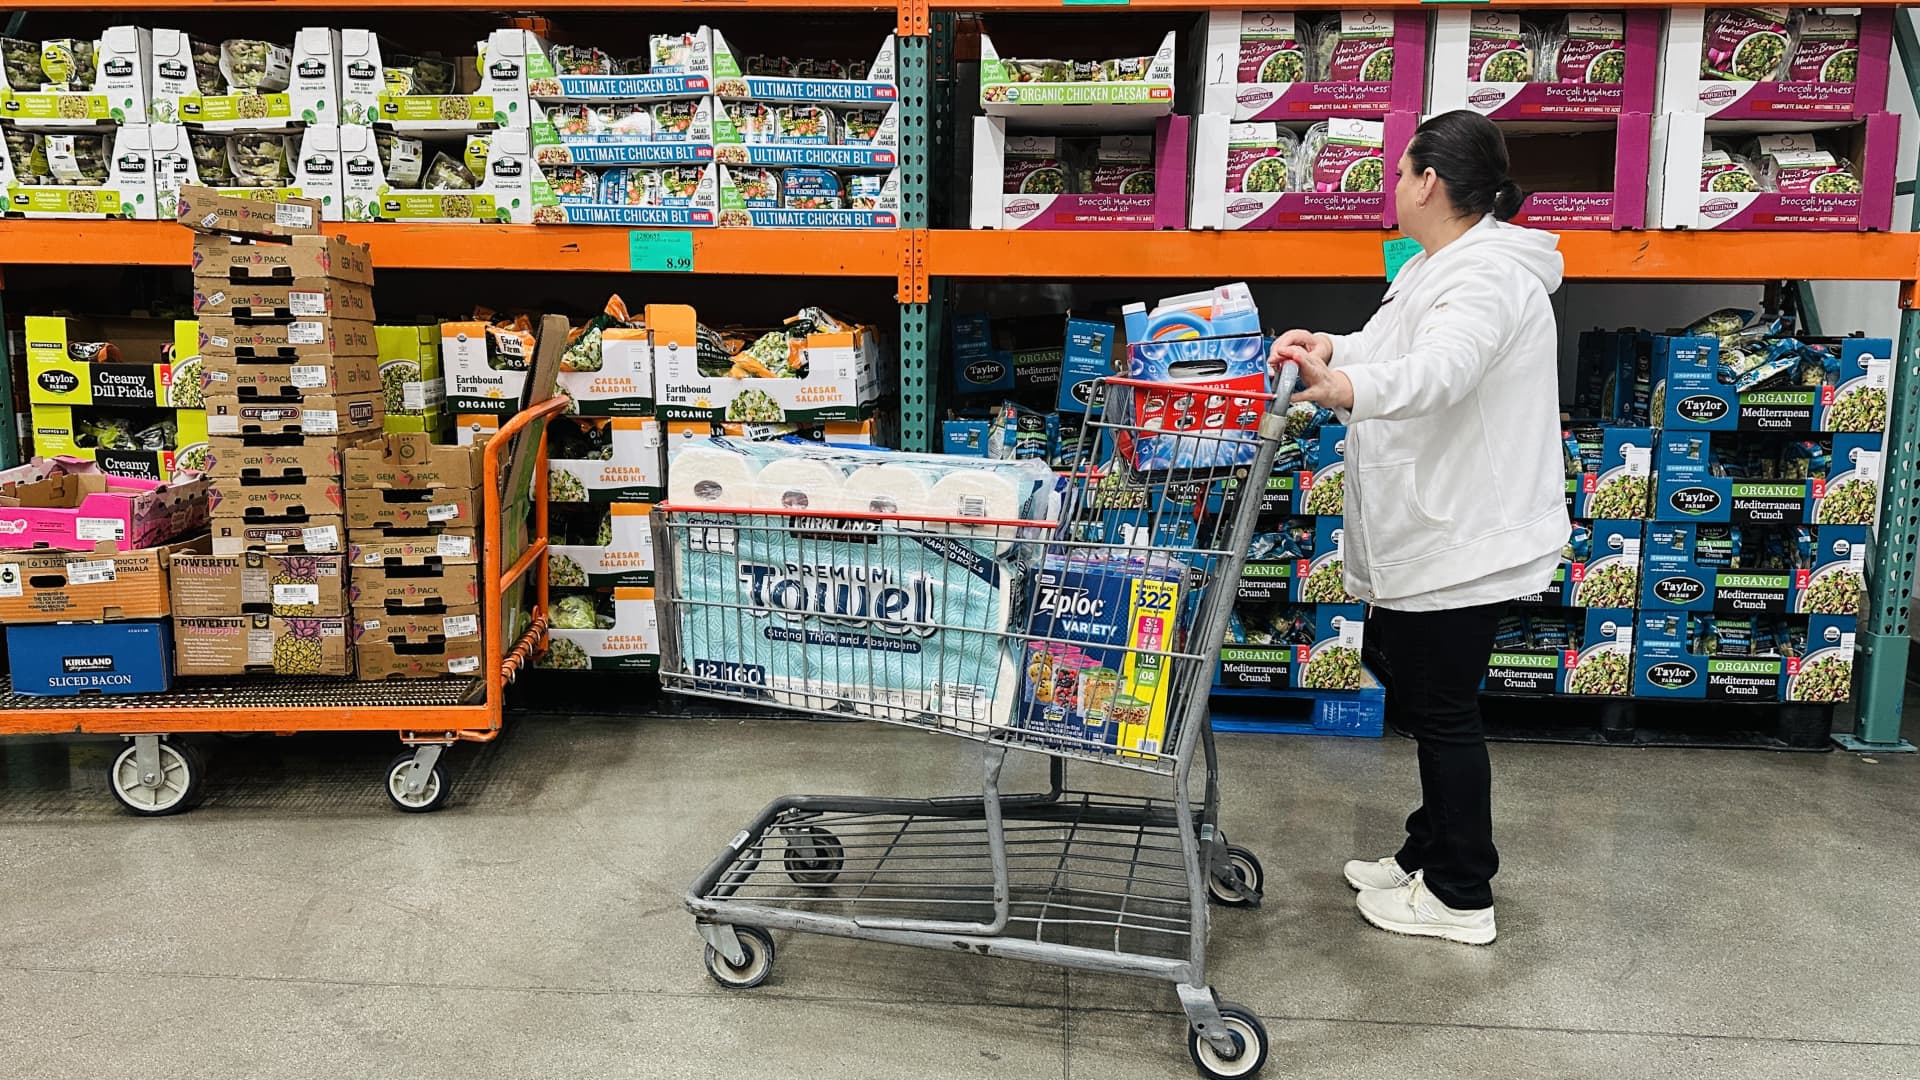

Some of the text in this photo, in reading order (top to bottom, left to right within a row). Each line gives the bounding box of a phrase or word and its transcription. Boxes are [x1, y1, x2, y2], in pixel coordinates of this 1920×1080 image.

[104, 65, 132, 74] Bistro
[350, 67, 375, 78] Bistro
[492, 68, 517, 77] Bistro
[566, 78, 705, 94] ULTIMATE CHICKEN BLT NEW!
[753, 83, 804, 97] ULTIMATE
[806, 84, 851, 98] CHICKEN
[854, 85, 872, 99] BLT
[1313, 84, 1387, 93] Broccoli Madness
[1546, 86, 1621, 96] Broccoli Madness
[1778, 84, 1852, 94] Broccoli Madness
[1021, 87, 1169, 102] ORGANIC CHICKEN CAESAR NEW!
[753, 150, 804, 163] ULTIMATE
[806, 150, 850, 164] CHICKEN
[853, 151, 872, 165] BLT
[120, 161, 145, 170] Bistro
[494, 164, 520, 174] Bistro
[1078, 196, 1150, 206] Broccoli Madness
[1304, 195, 1379, 205] Broccoli Madness
[1532, 196, 1608, 205] Broccoli Madness
[1781, 197, 1856, 206] Broccoli Madness
[217, 208, 275, 220] GEM PACK
[571, 208, 709, 223] ULTIMATE CHICKEN BLT NEW!
[756, 211, 892, 226] ULTIMATE CHICKEN BLT NEW!
[231, 255, 287, 263] GEM PACK
[666, 258, 691, 269] 8.99
[233, 336, 288, 344] GEM PACK
[1018, 352, 1060, 363] ORGANI
[970, 365, 999, 376] Taylor
[42, 373, 75, 385] Taylor
[99, 372, 146, 387] Creamy
[163, 372, 170, 382] 2
[456, 375, 503, 385] Earthbound
[594, 377, 631, 385] CAESAR
[93, 386, 154, 398] Dill Pickle
[456, 384, 477, 393] Farm
[666, 384, 711, 394] Earthbound
[800, 386, 836, 394] CAESAR
[666, 393, 687, 402] Farm
[795, 394, 843, 402] SALAD KIT
[1748, 393, 1808, 404] ORGANIC
[1824, 391, 1832, 401] 2
[458, 401, 506, 409] ORGANIC
[1684, 399, 1721, 413] Taylor
[667, 410, 713, 418] ORGANIC
[1742, 408, 1810, 420] Mediterranean
[1758, 417, 1792, 428] Crunch
[105, 458, 150, 472] Creamy
[166, 459, 173, 467] 2
[244, 457, 299, 465] GEM PACK
[376, 472, 439, 481] GEM PACK
[1739, 485, 1798, 496] ORGANIC
[1815, 484, 1822, 494] 2
[1677, 491, 1714, 505] Taylor
[1734, 500, 1801, 512] Mediterranean
[1750, 509, 1784, 520] Crunch
[173, 558, 239, 567] POWERFUL
[600, 559, 629, 567] SALAD
[181, 566, 232, 575] Pineapple
[1300, 564, 1306, 573] 2
[1723, 575, 1782, 586] ORGANIC
[1799, 575, 1806, 585] 2
[387, 586, 439, 595] GEM PACK
[1238, 589, 1271, 598] Crunch
[1662, 582, 1698, 595] Taylor
[741, 564, 930, 632] Towel
[1136, 590, 1171, 610] 322
[1669, 591, 1690, 599] FARMS
[1717, 590, 1784, 601] Mediterranean
[1040, 588, 1104, 618] Ziploc
[1733, 600, 1766, 610] Crunch
[180, 618, 246, 628] POWERFUL
[188, 627, 240, 635] Pineapple
[809, 632, 836, 643] Thick
[839, 636, 859, 645] and
[862, 638, 917, 651] Absorbent
[1228, 651, 1284, 660] ORGANIC
[1300, 650, 1306, 659] 2
[1568, 655, 1574, 664] 2
[64, 658, 112, 667] KIRKLAND
[1494, 655, 1551, 665] ORGANIC
[1789, 660, 1797, 670] 2
[1223, 663, 1287, 674] Mediterranean
[1716, 662, 1773, 672] ORGANIC
[698, 663, 761, 684] 12 160
[1239, 673, 1271, 683] Crunch
[1488, 669, 1554, 680] Mediterranean
[1654, 667, 1691, 680] Taylor
[49, 675, 132, 687] SLICED BACON
[1504, 679, 1537, 688] Crunch
[1710, 675, 1776, 687] Mediterranean
[1725, 685, 1758, 695] Crunch
